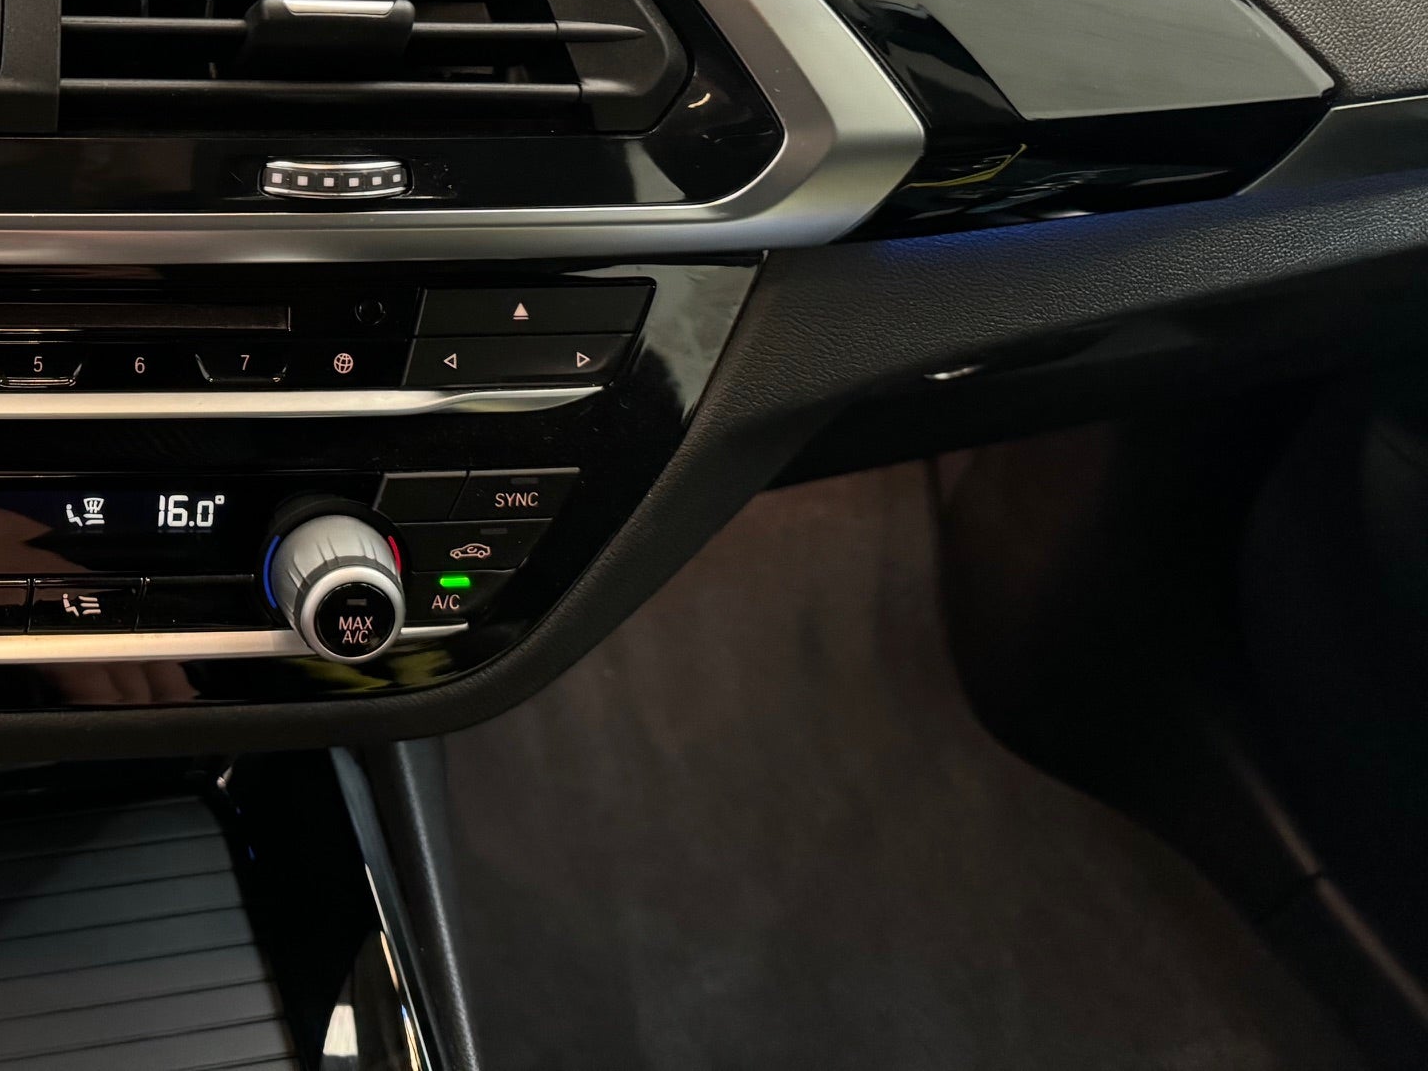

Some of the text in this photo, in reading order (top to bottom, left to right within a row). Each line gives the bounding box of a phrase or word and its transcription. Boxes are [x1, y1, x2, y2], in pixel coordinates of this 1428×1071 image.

[33, 355, 43, 373] 5
[134, 356, 146, 374] 6
[240, 354, 250, 371] 7
[494, 491, 539, 508] SYNC
[431, 594, 460, 611] A/C
[338, 616, 373, 631] MAX
[342, 629, 369, 644] A/C
